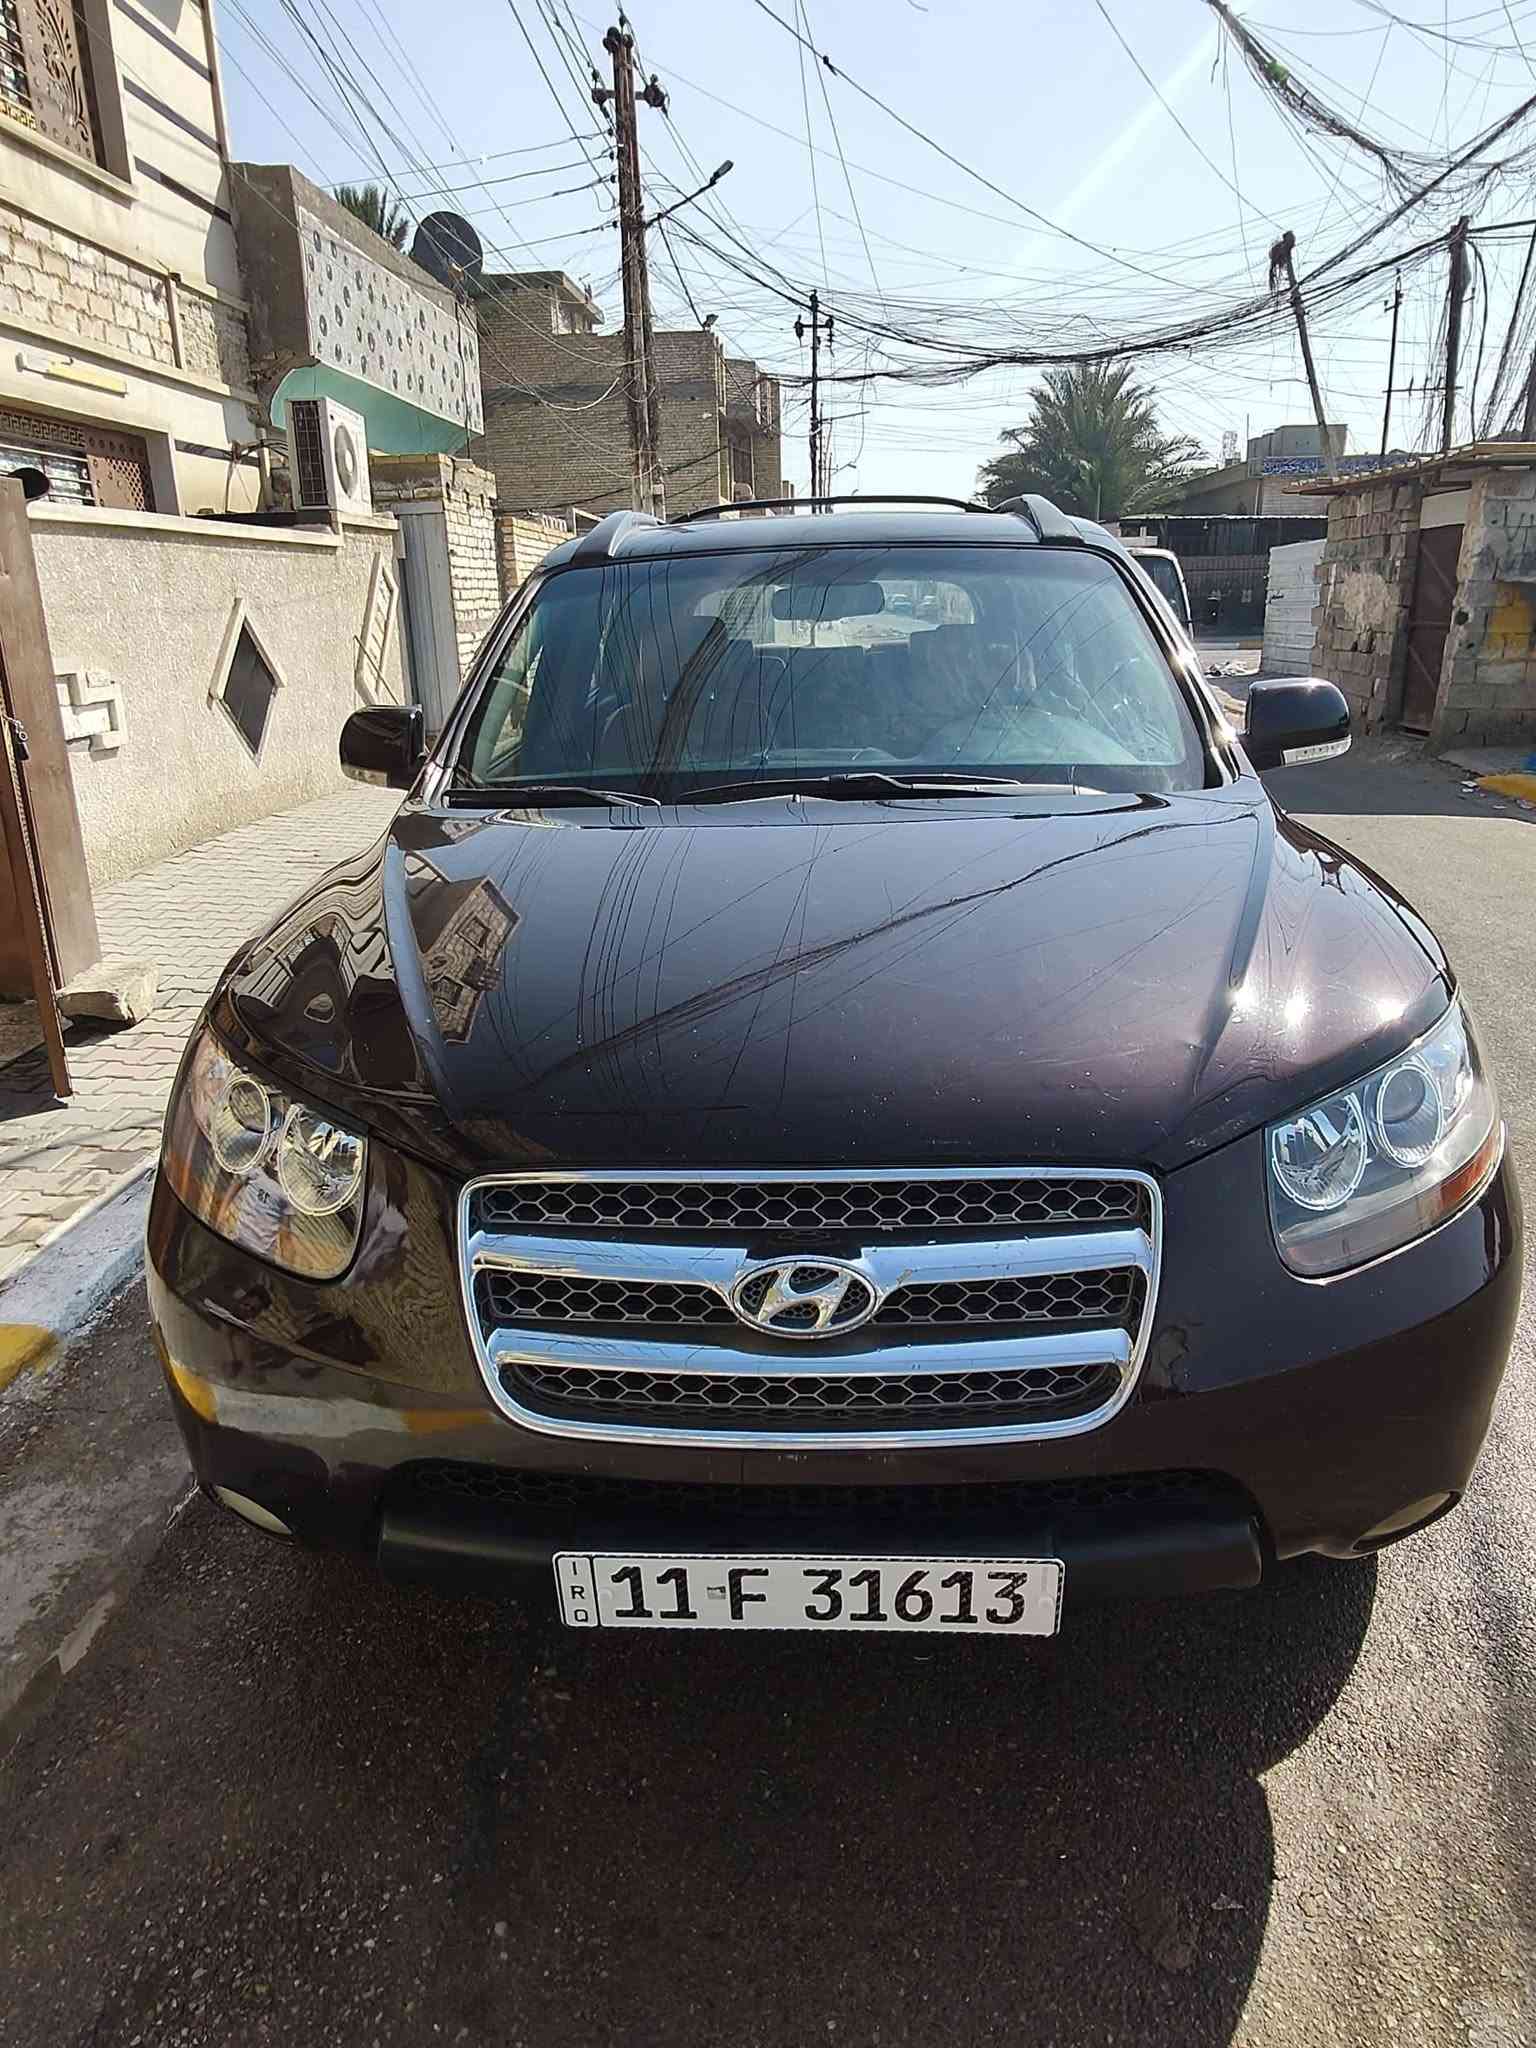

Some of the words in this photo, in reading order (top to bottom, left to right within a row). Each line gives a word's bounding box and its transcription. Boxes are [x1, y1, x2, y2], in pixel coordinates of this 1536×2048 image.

[611, 1566, 698, 1620] 11
[727, 1568, 769, 1620] F
[802, 1569, 1028, 1625] 31613
